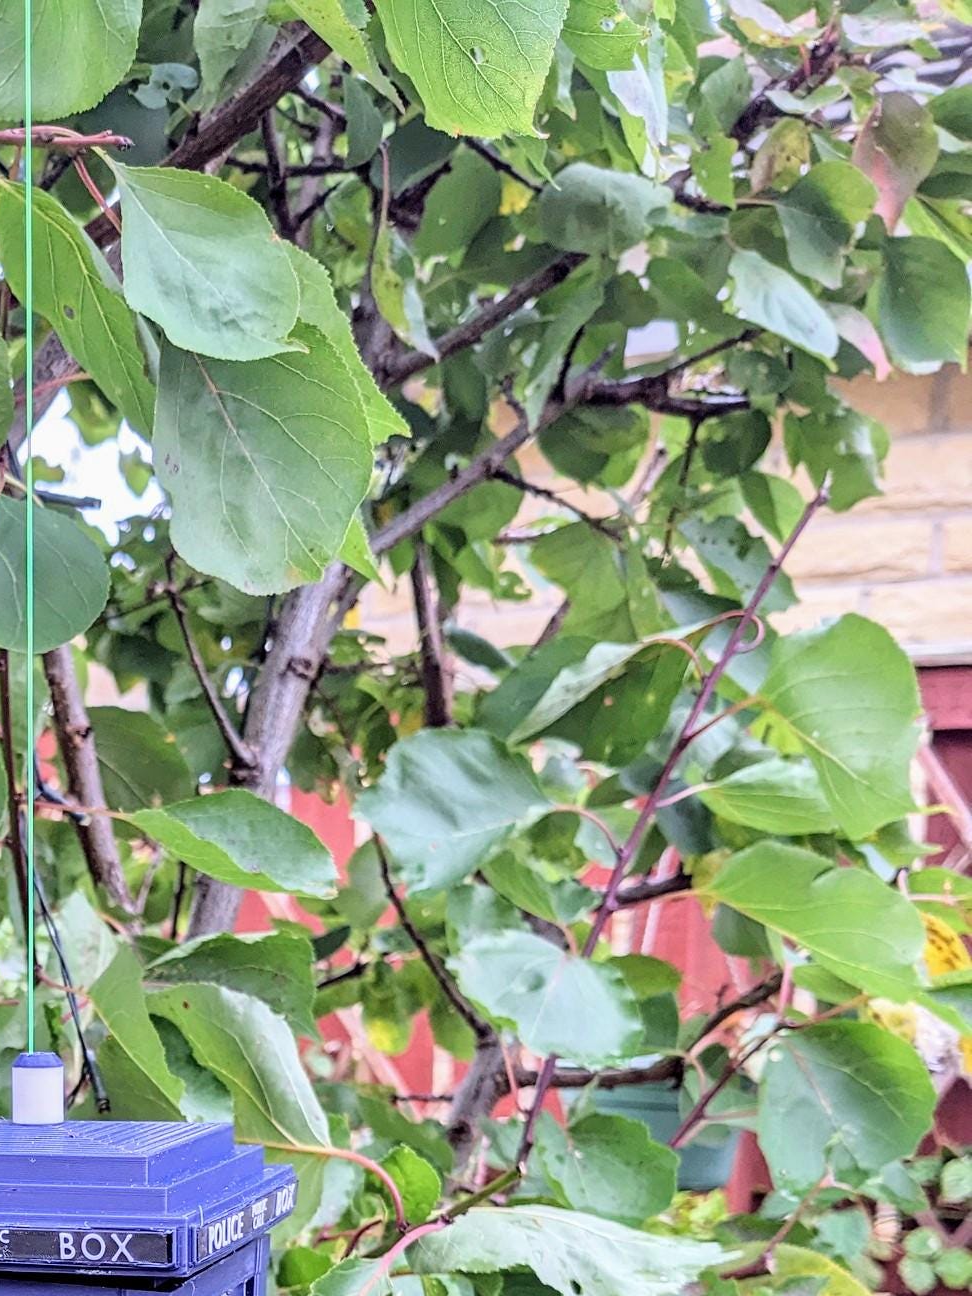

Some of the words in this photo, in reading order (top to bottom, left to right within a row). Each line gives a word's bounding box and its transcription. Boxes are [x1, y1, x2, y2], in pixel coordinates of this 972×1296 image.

[275, 1183, 295, 1217] BOX
[59, 1233, 134, 1262] BOX
[208, 1212, 244, 1254] POLICE
